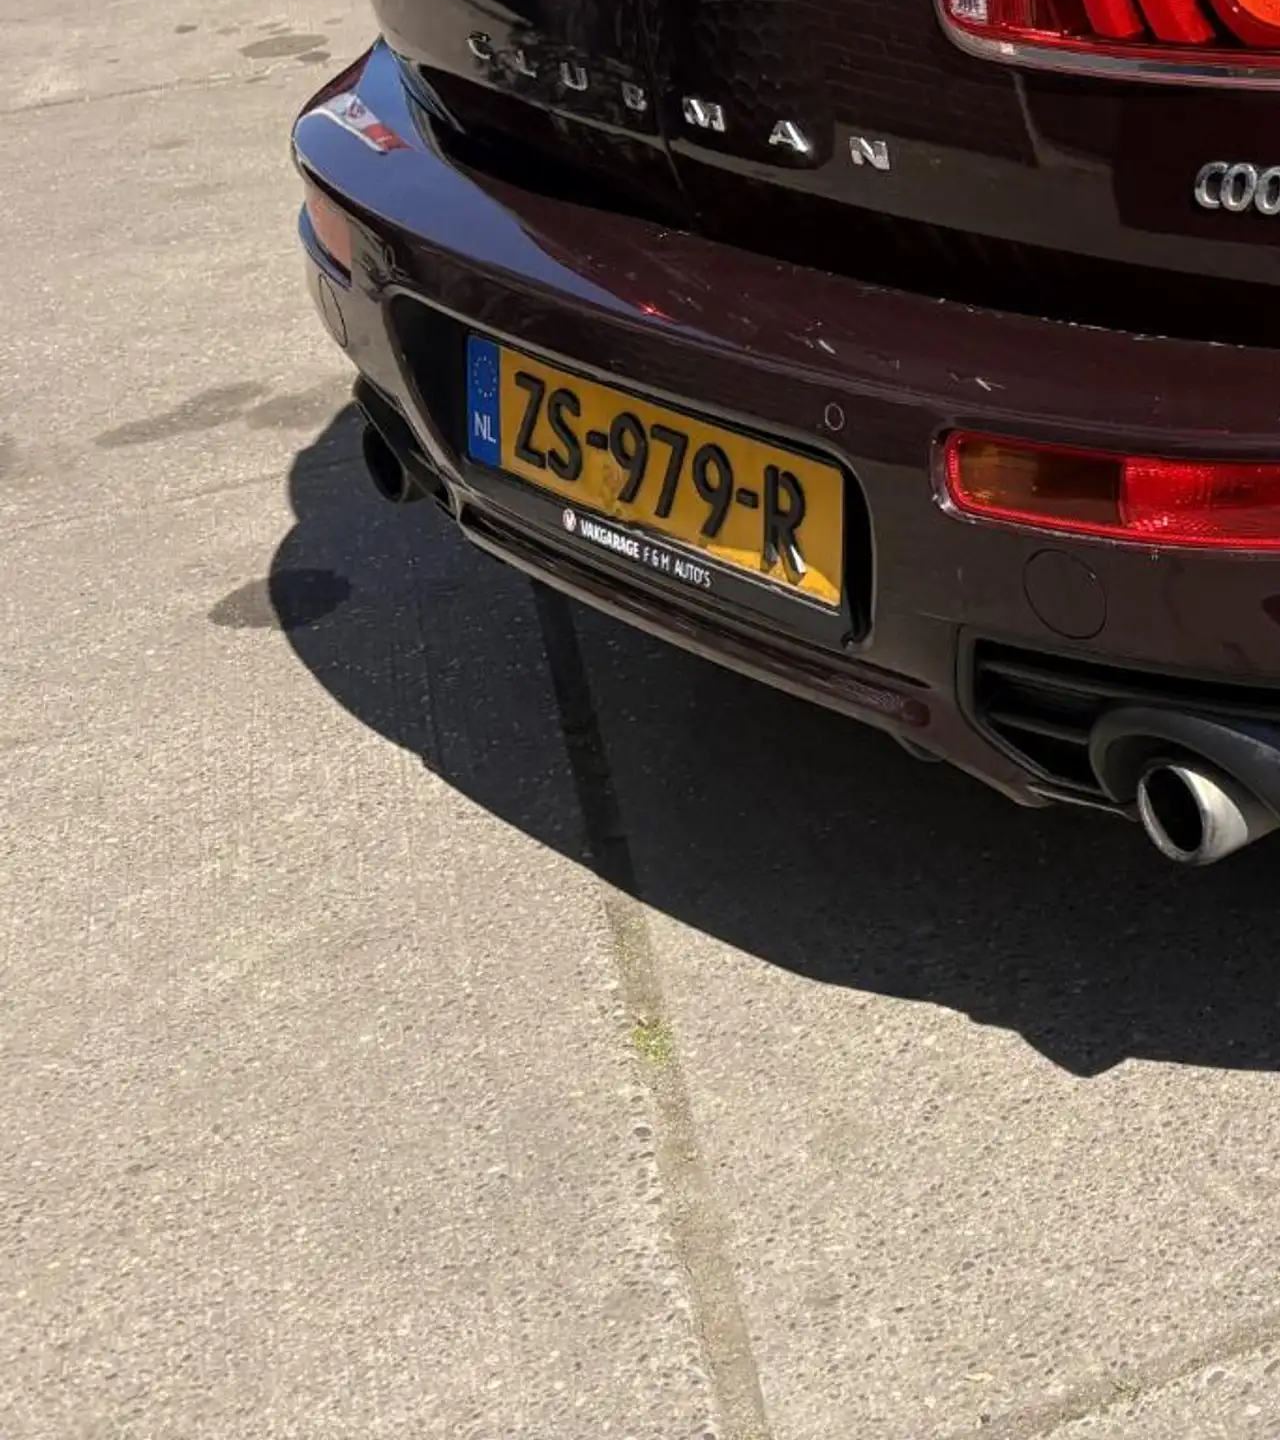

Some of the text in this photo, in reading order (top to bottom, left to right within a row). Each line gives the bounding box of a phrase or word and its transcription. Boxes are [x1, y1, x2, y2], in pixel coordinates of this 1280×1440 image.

[465, 29, 890, 171] CLUBMAN
[474, 410, 497, 444] NL
[512, 370, 807, 581] ZS-979-R
[580, 518, 640, 559] VAKGARAGE
[674, 559, 711, 588] AUTO'S
